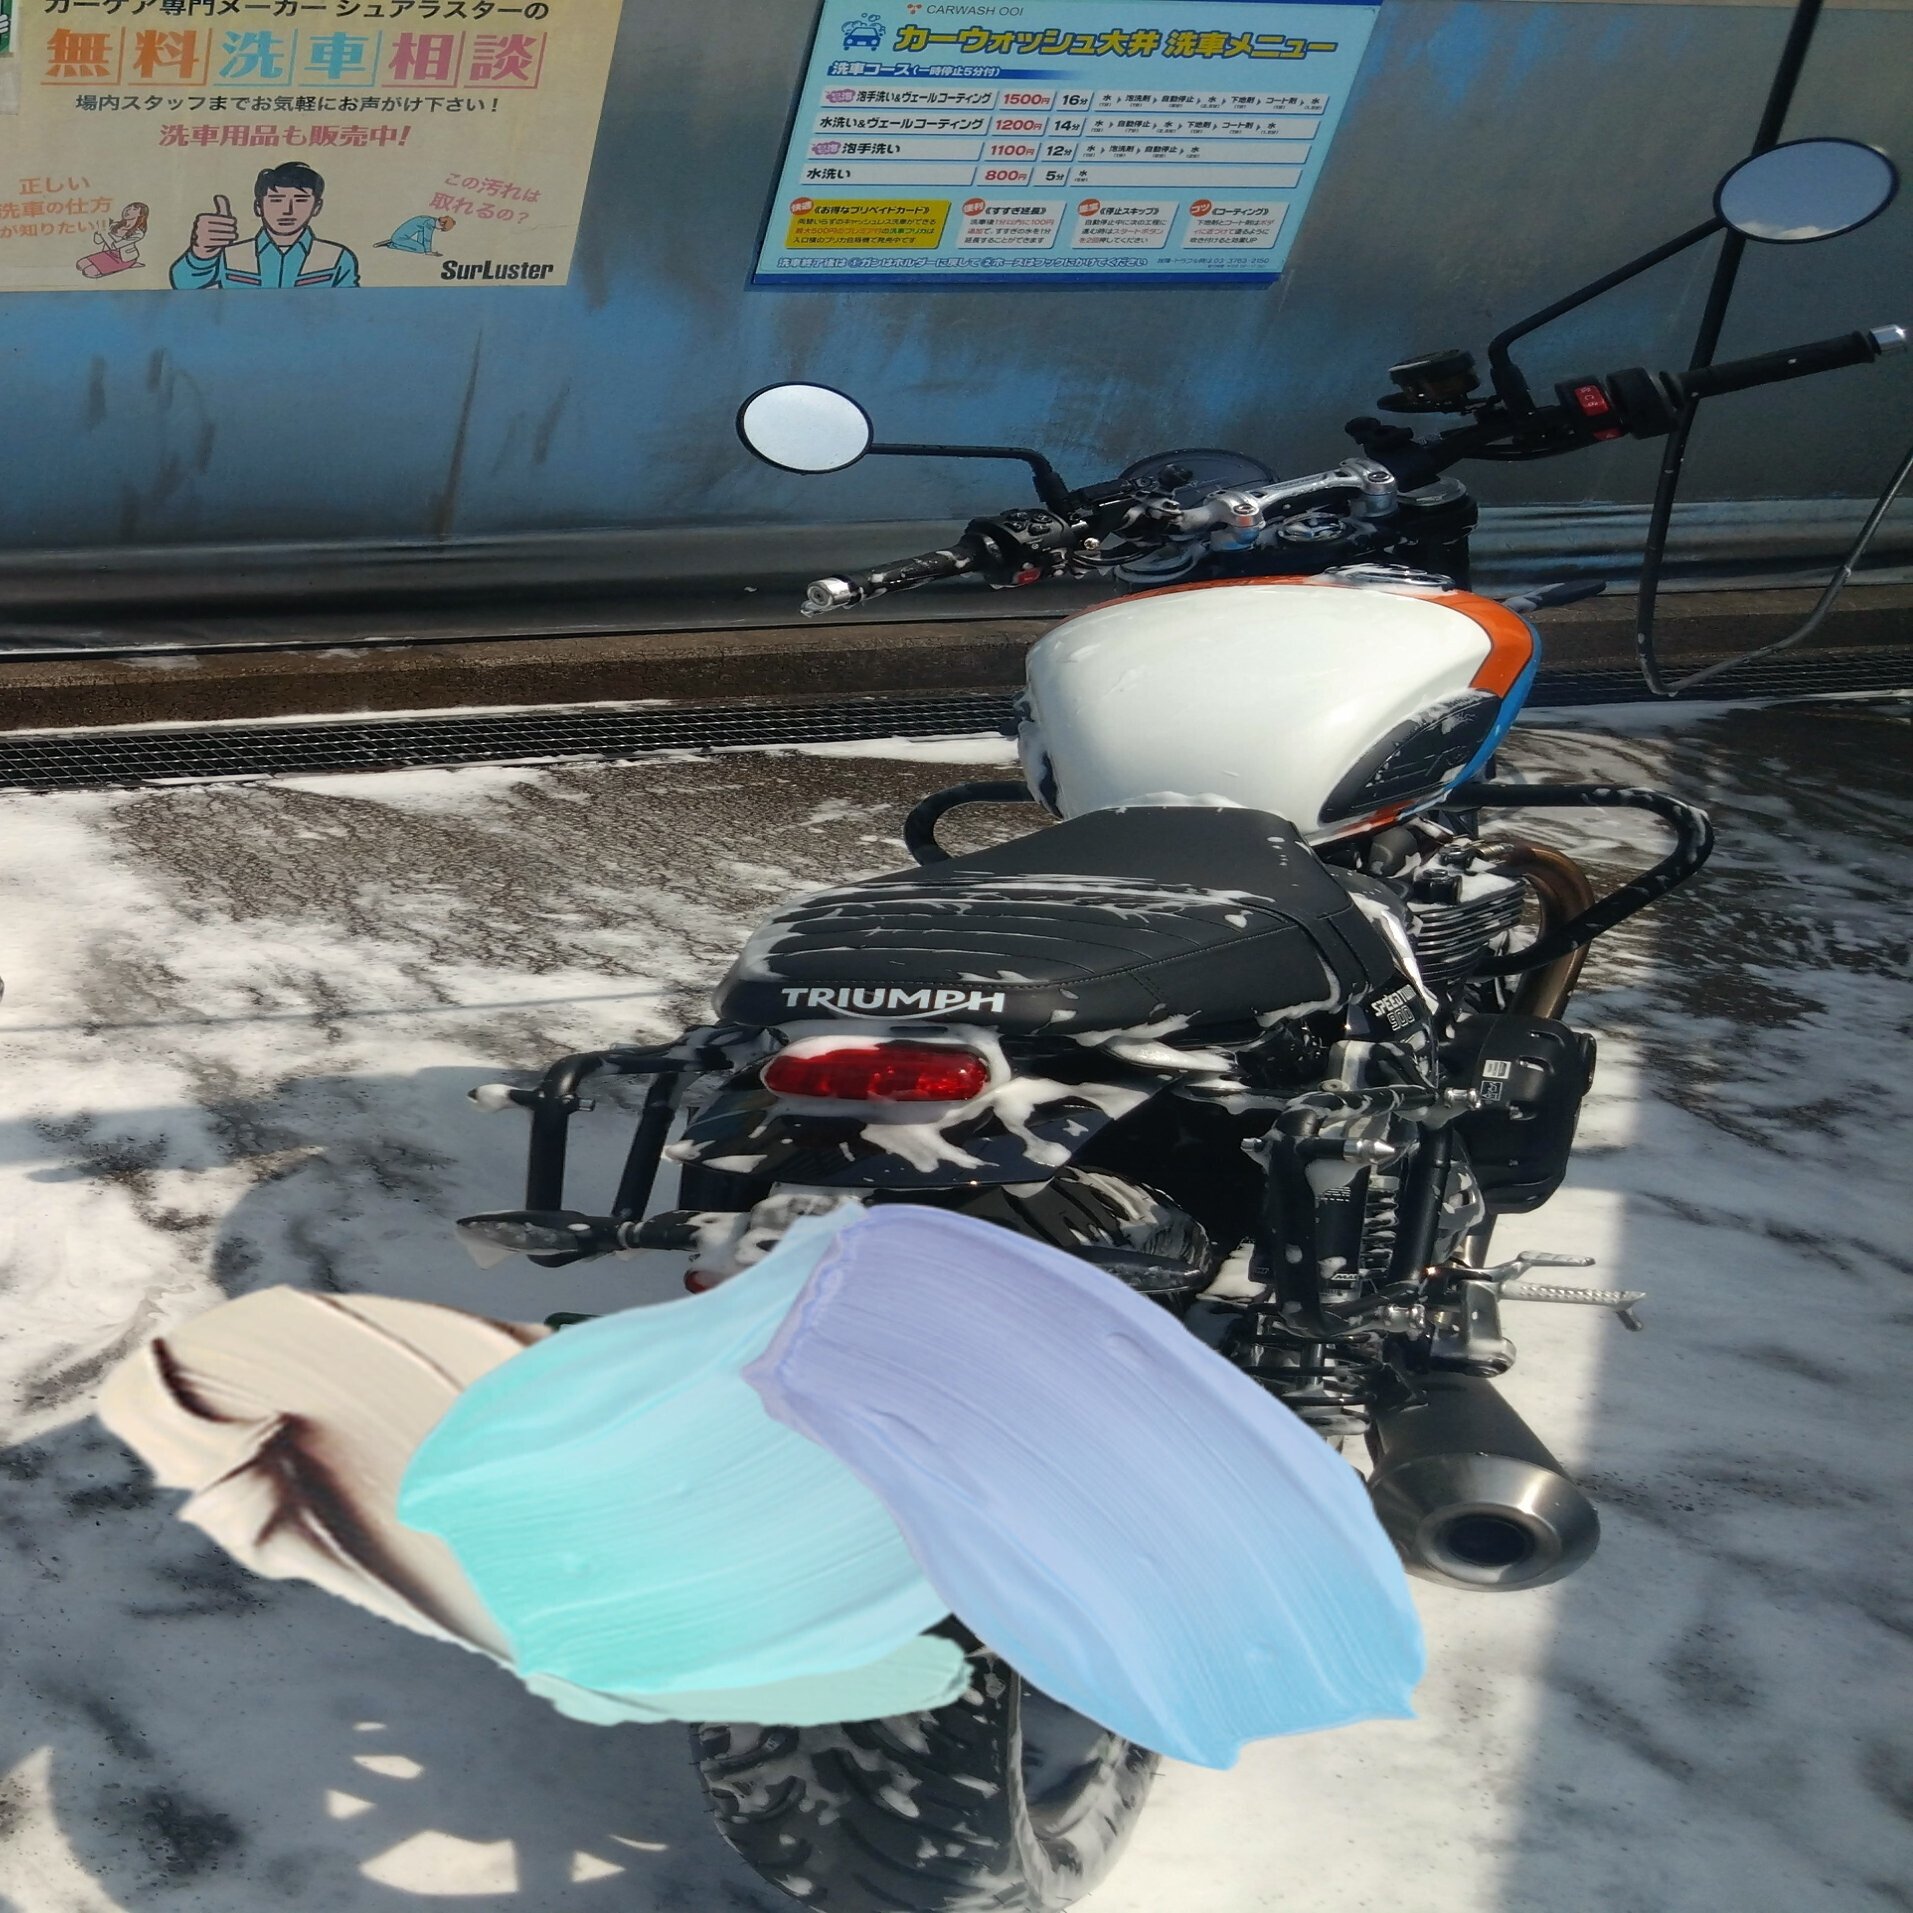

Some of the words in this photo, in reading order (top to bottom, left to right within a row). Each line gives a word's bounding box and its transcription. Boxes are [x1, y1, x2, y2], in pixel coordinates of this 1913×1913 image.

[44, 0, 327, 17] カーケア専門メーカー
[336, 0, 550, 20] シュアラスターの
[926, 4, 996, 16] CARWASH
[893, 24, 1163, 57] カーウォッシュ大井
[1163, 30, 1338, 60] 洗車メニュー
[45, 28, 536, 83] 無料洗車相談
[75, 94, 499, 112] 場内スタッフまでお気軽にお声がけ下さい!
[1003, 93, 1051, 105] 1500円
[1062, 94, 1088, 106] 16分
[1102, 94, 1112, 102] 水
[158, 124, 412, 147] 洗車用品も販売中!
[995, 119, 1043, 131] 1200円
[1054, 120, 1081, 132] 14分
[842, 142, 901, 155] 泡手洗い
[990, 145, 1036, 157] 1100円
[1047, 146, 1073, 157] 12分
[806, 167, 851, 180] 水洗い
[985, 169, 1027, 182] 800円
[1045, 170, 1065, 182] 5分
[19, 176, 91, 196] 正しい
[445, 173, 542, 203] この汚れは
[429, 192, 530, 224] 取れるの?
[440, 260, 554, 280] SurLuster
[781, 987, 1006, 1016] TRIUMPH
[1386, 1004, 1415, 1031] 900
